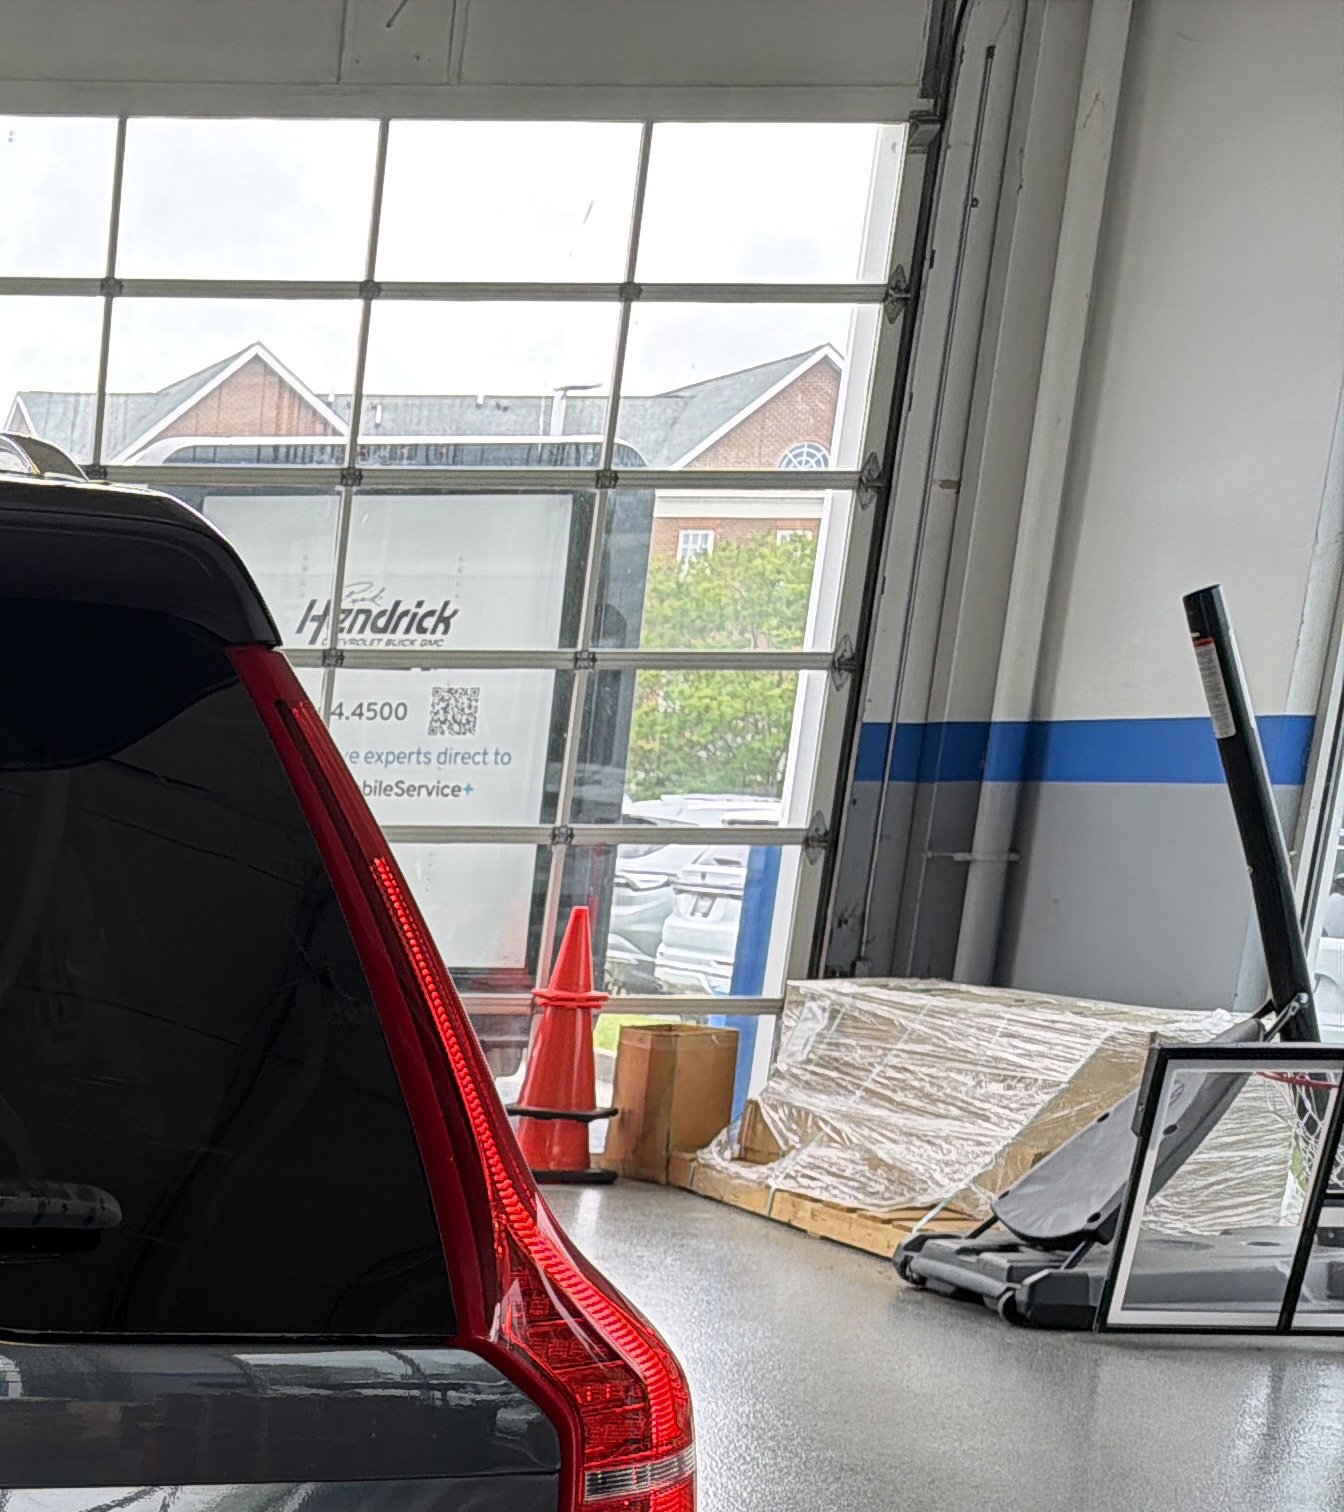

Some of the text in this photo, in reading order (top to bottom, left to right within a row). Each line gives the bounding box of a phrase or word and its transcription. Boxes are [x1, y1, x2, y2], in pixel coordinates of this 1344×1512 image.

[364, 747, 431, 768] experts
[437, 747, 488, 766] direct
[493, 748, 512, 765] to
